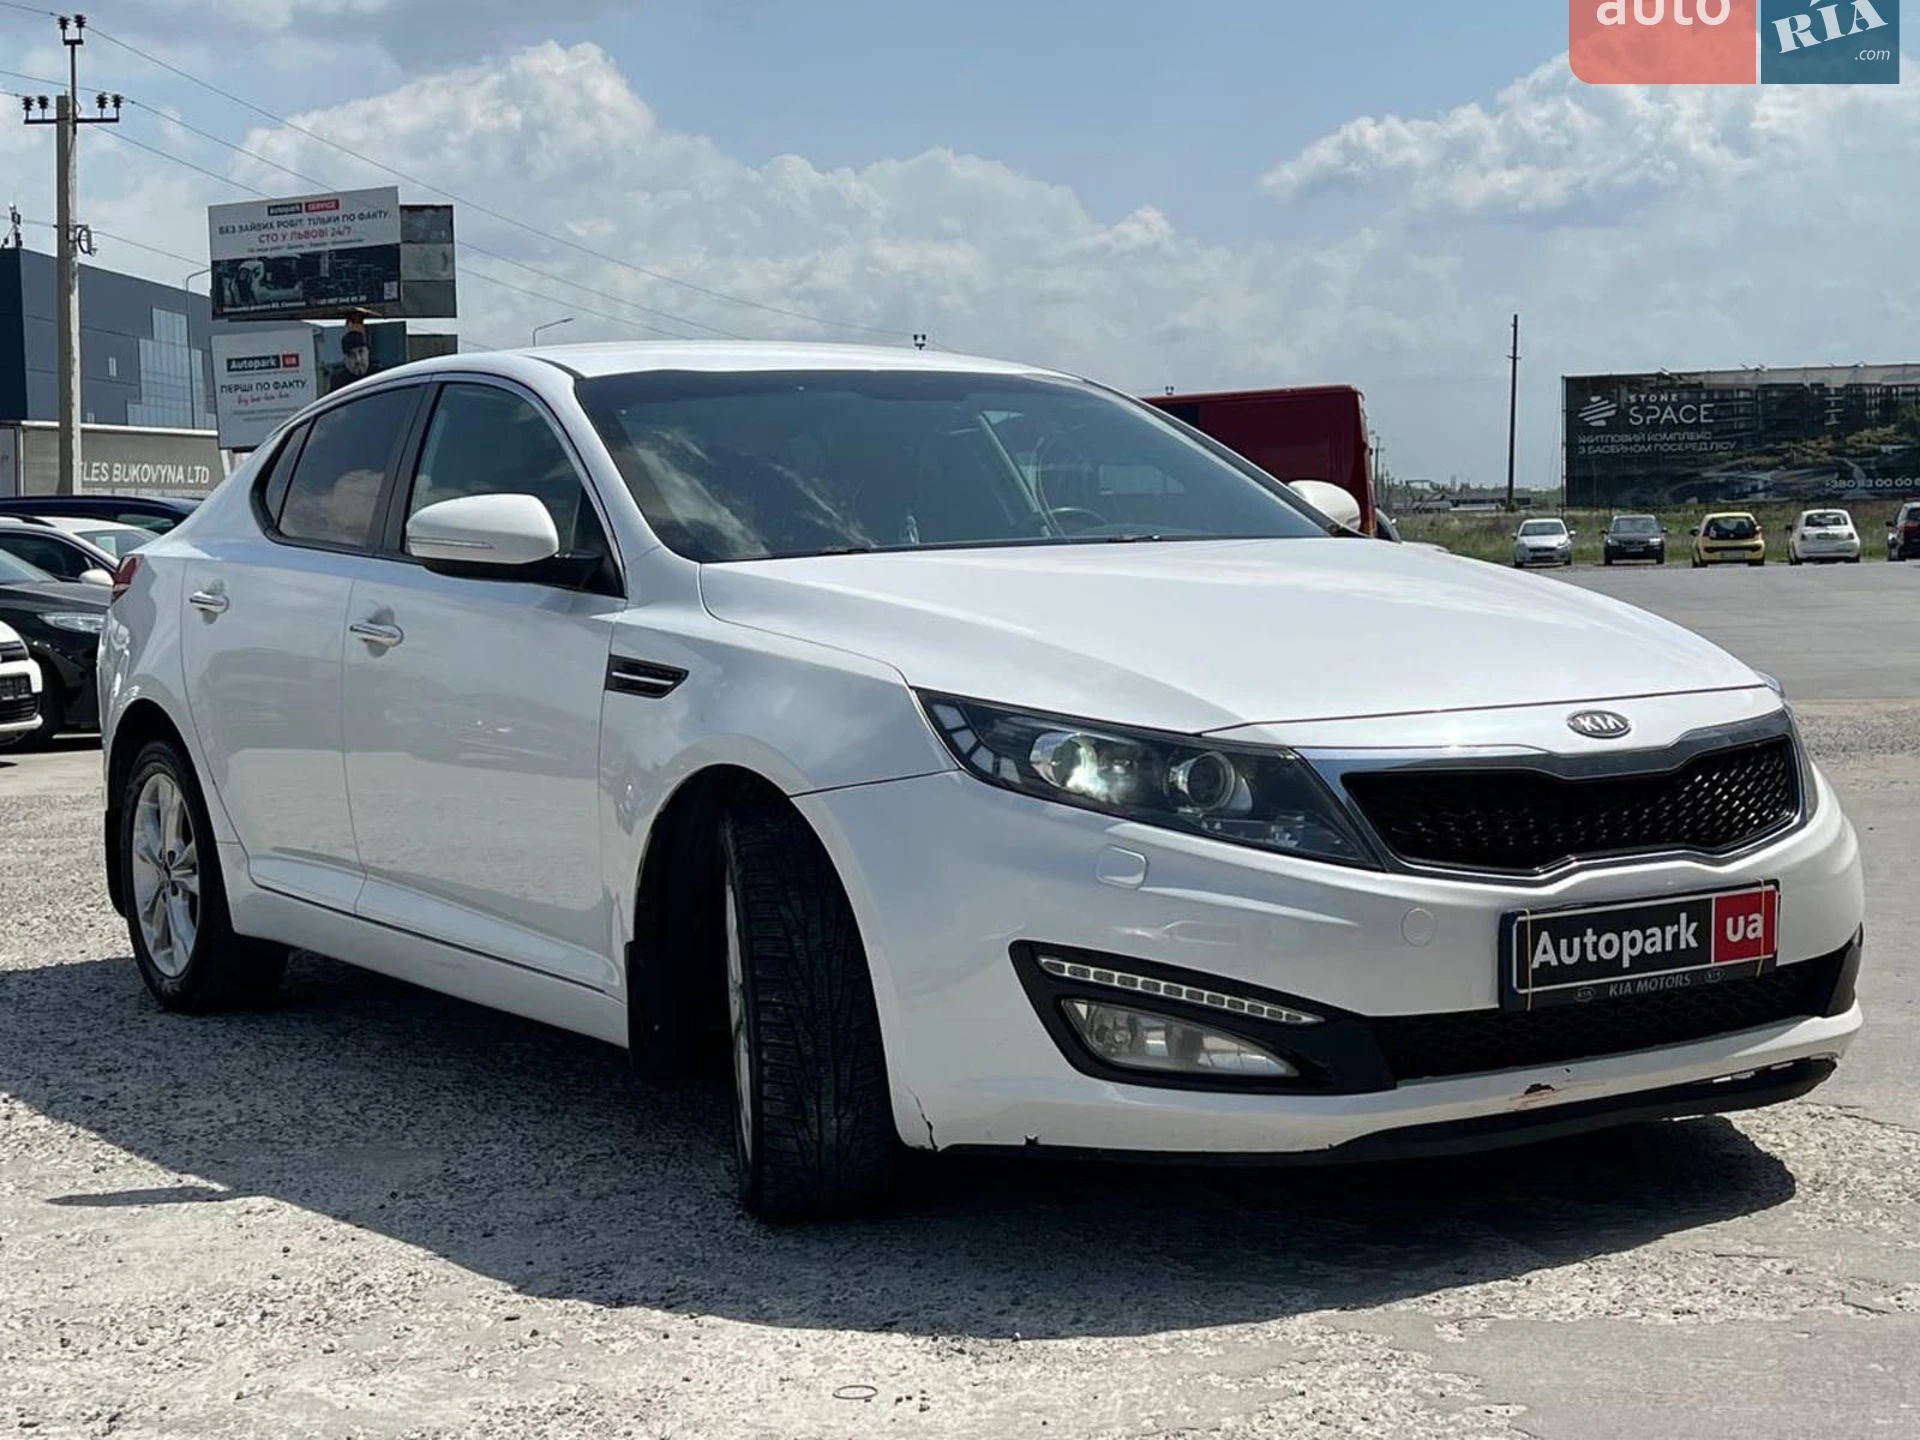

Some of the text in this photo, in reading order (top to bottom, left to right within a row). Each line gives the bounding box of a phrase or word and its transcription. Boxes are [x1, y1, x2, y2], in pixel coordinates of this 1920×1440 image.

[341, 213, 356, 222] ПО
[258, 226, 352, 244] СТО У ЛЬВОВІ 24/7
[229, 356, 278, 371] Autopark
[220, 383, 254, 394] ПЕРШІ
[255, 381, 271, 391] ПО
[1628, 393, 1679, 403] STONE
[1629, 403, 1715, 426] SPACE
[1577, 430, 1712, 445] ЖИТЛОВИЙ КОМПЛЕКС
[1588, 443, 1652, 455] БАСЕЙНОМ
[1653, 441, 1709, 452] ПОСЕРЕД
[1709, 440, 1738, 451] ЛІСУ
[83, 461, 210, 484] LES BUKOVYNA LTD
[1875, 477, 1893, 487] 00
[1894, 475, 1913, 486] 00
[1531, 912, 1764, 969] Autopark ua
[1608, 982, 1634, 998] KIA
[1634, 973, 1692, 994] MOTORS
